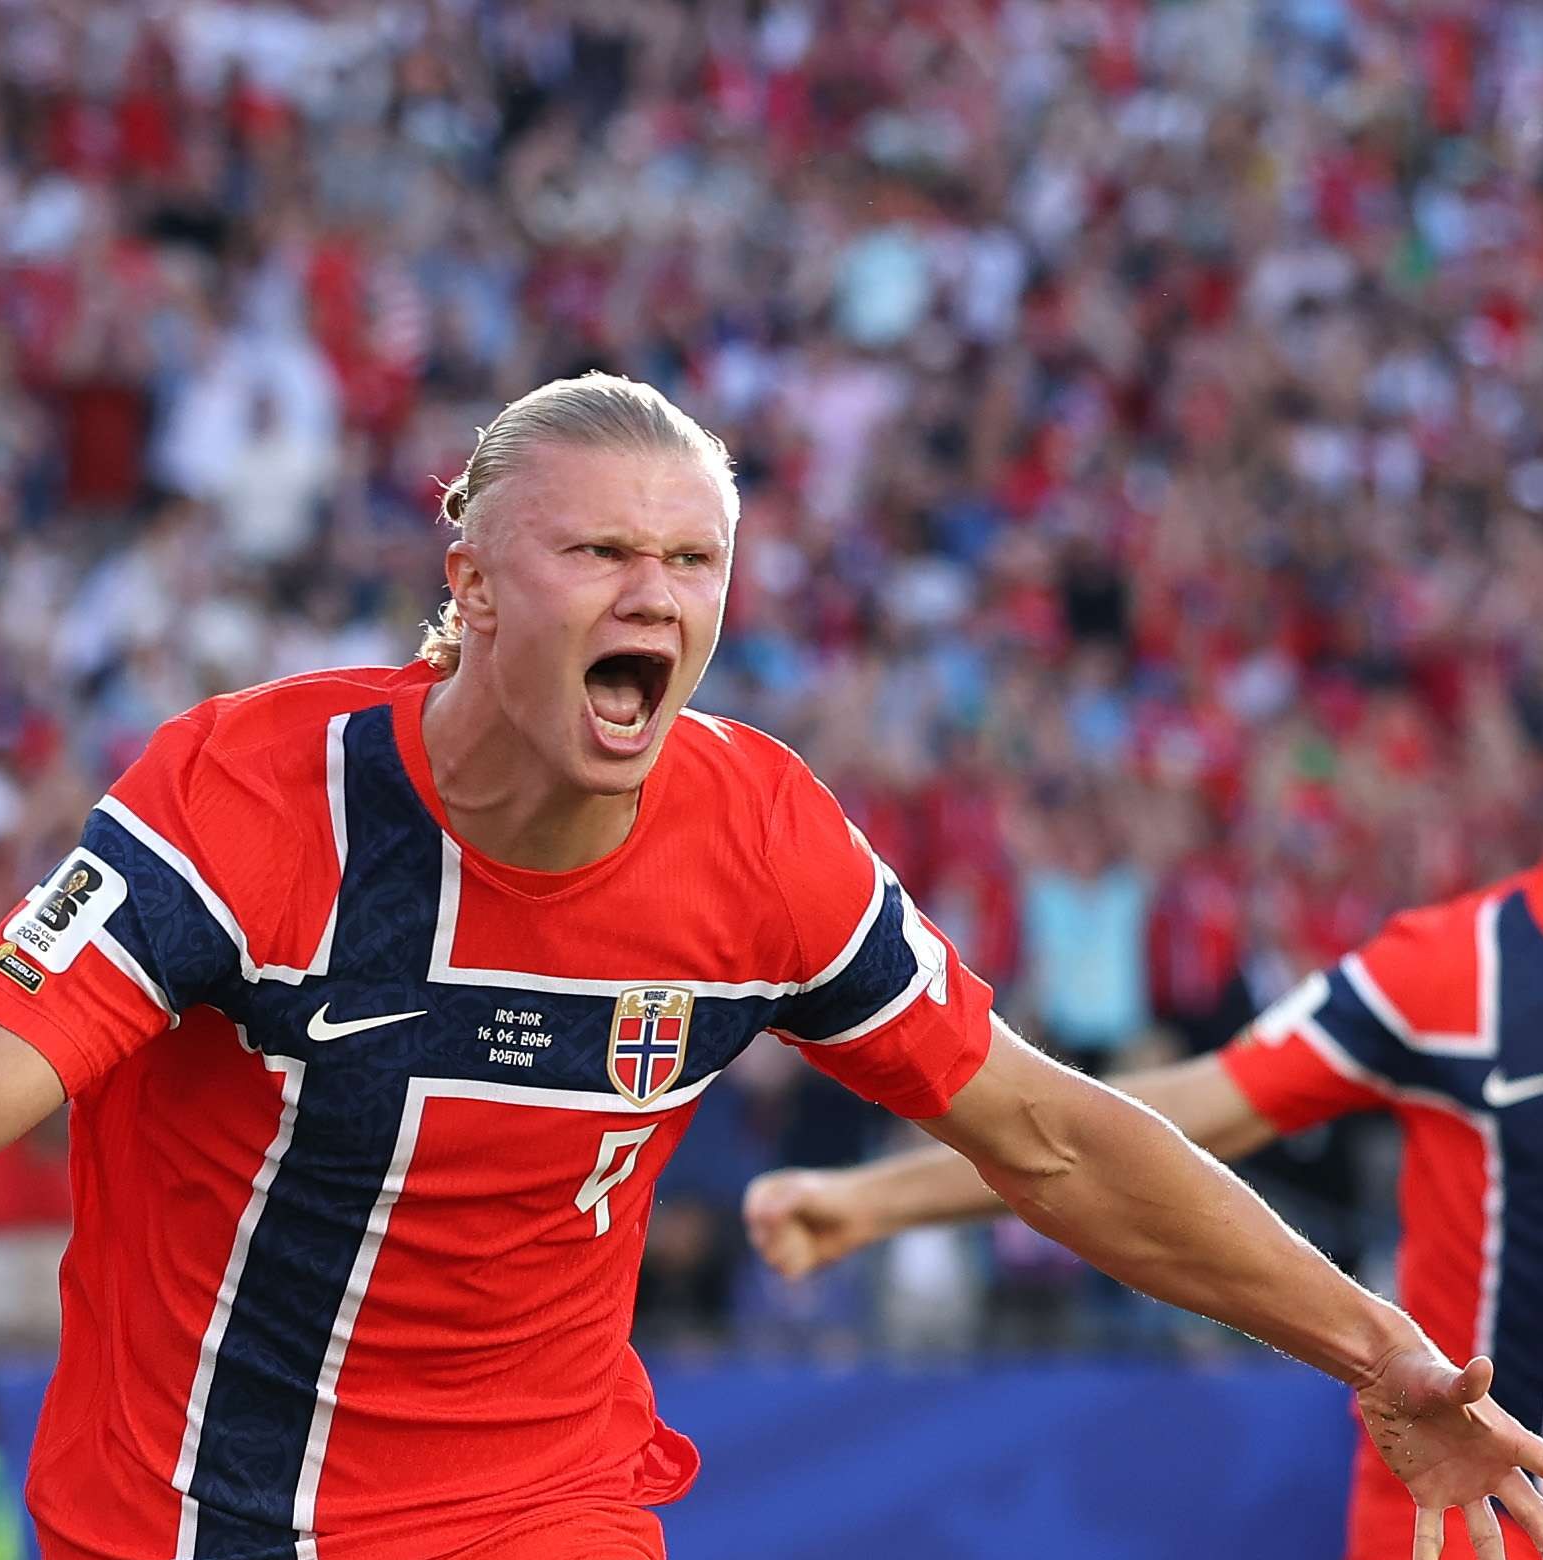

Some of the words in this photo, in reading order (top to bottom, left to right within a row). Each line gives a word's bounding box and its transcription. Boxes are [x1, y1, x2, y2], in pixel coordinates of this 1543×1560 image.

[40, 907, 58, 924] FIFA
[16, 926, 50, 952] 2026
[4, 956, 40, 982] DEBUT
[495, 1008, 543, 1027] IRQ-NOR
[488, 1047, 534, 1067] BOSTON
[573, 1122, 659, 1238] 9
